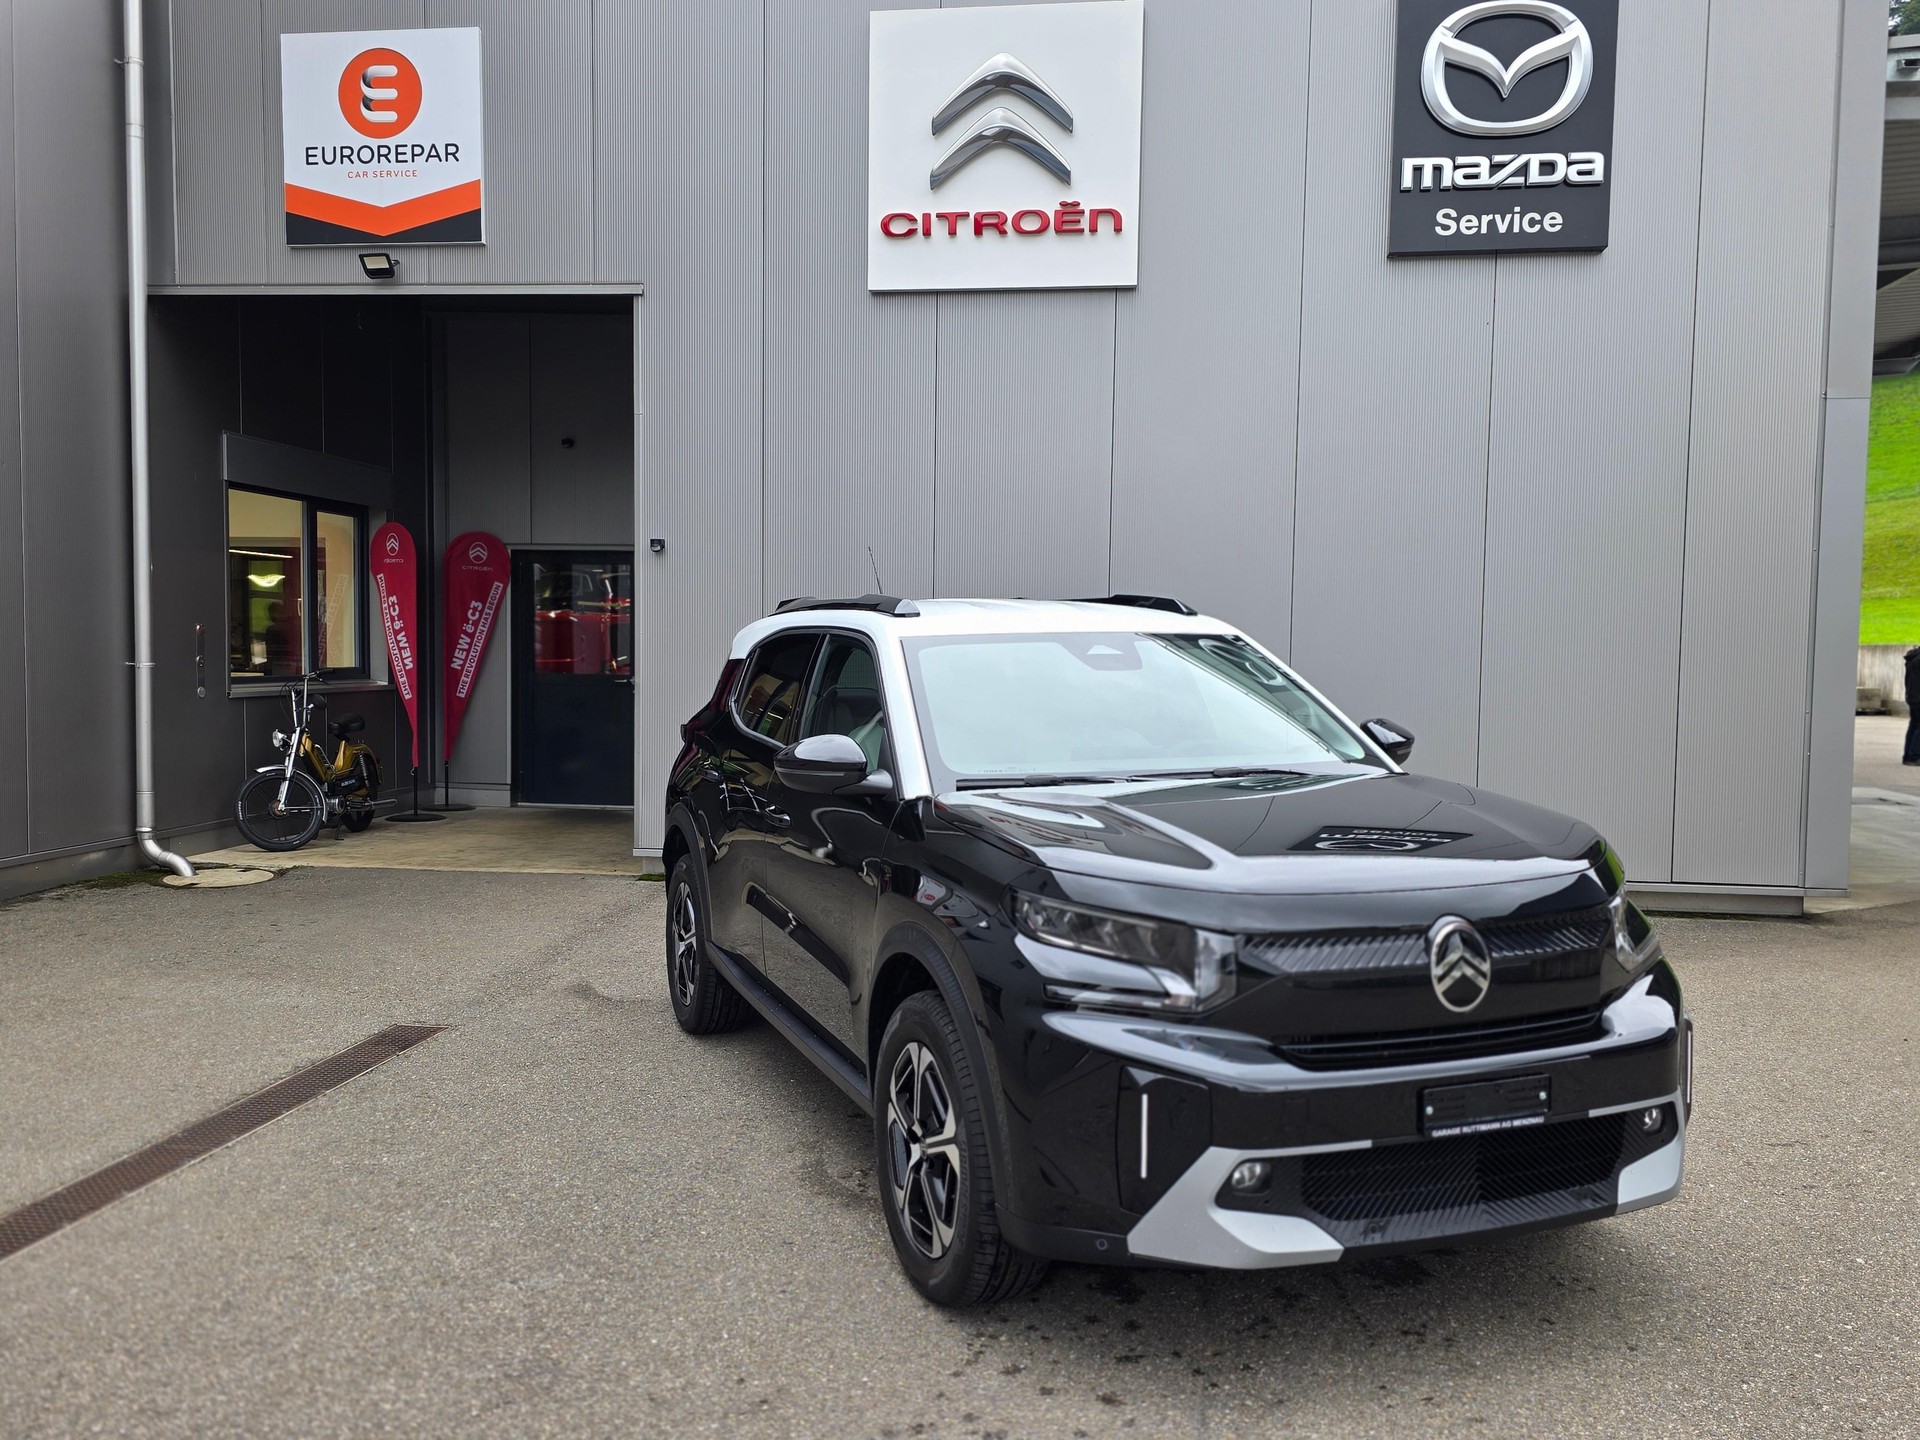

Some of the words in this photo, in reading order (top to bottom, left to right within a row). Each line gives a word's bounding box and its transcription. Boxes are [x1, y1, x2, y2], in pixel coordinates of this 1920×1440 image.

[305, 143, 460, 166] EUROREPAR
[1400, 151, 1605, 191] mazda
[347, 171, 369, 179] CAR
[372, 170, 418, 178] SERVICE
[880, 200, 1123, 238] CITROËN
[1434, 206, 1564, 236] Service
[450, 634, 471, 670] NEW
[463, 600, 483, 633] ë-C3
[458, 679, 469, 695] THE
[464, 629, 486, 679] REVOLUTION
[480, 611, 492, 629] HAS
[486, 583, 502, 611] BEGUN
